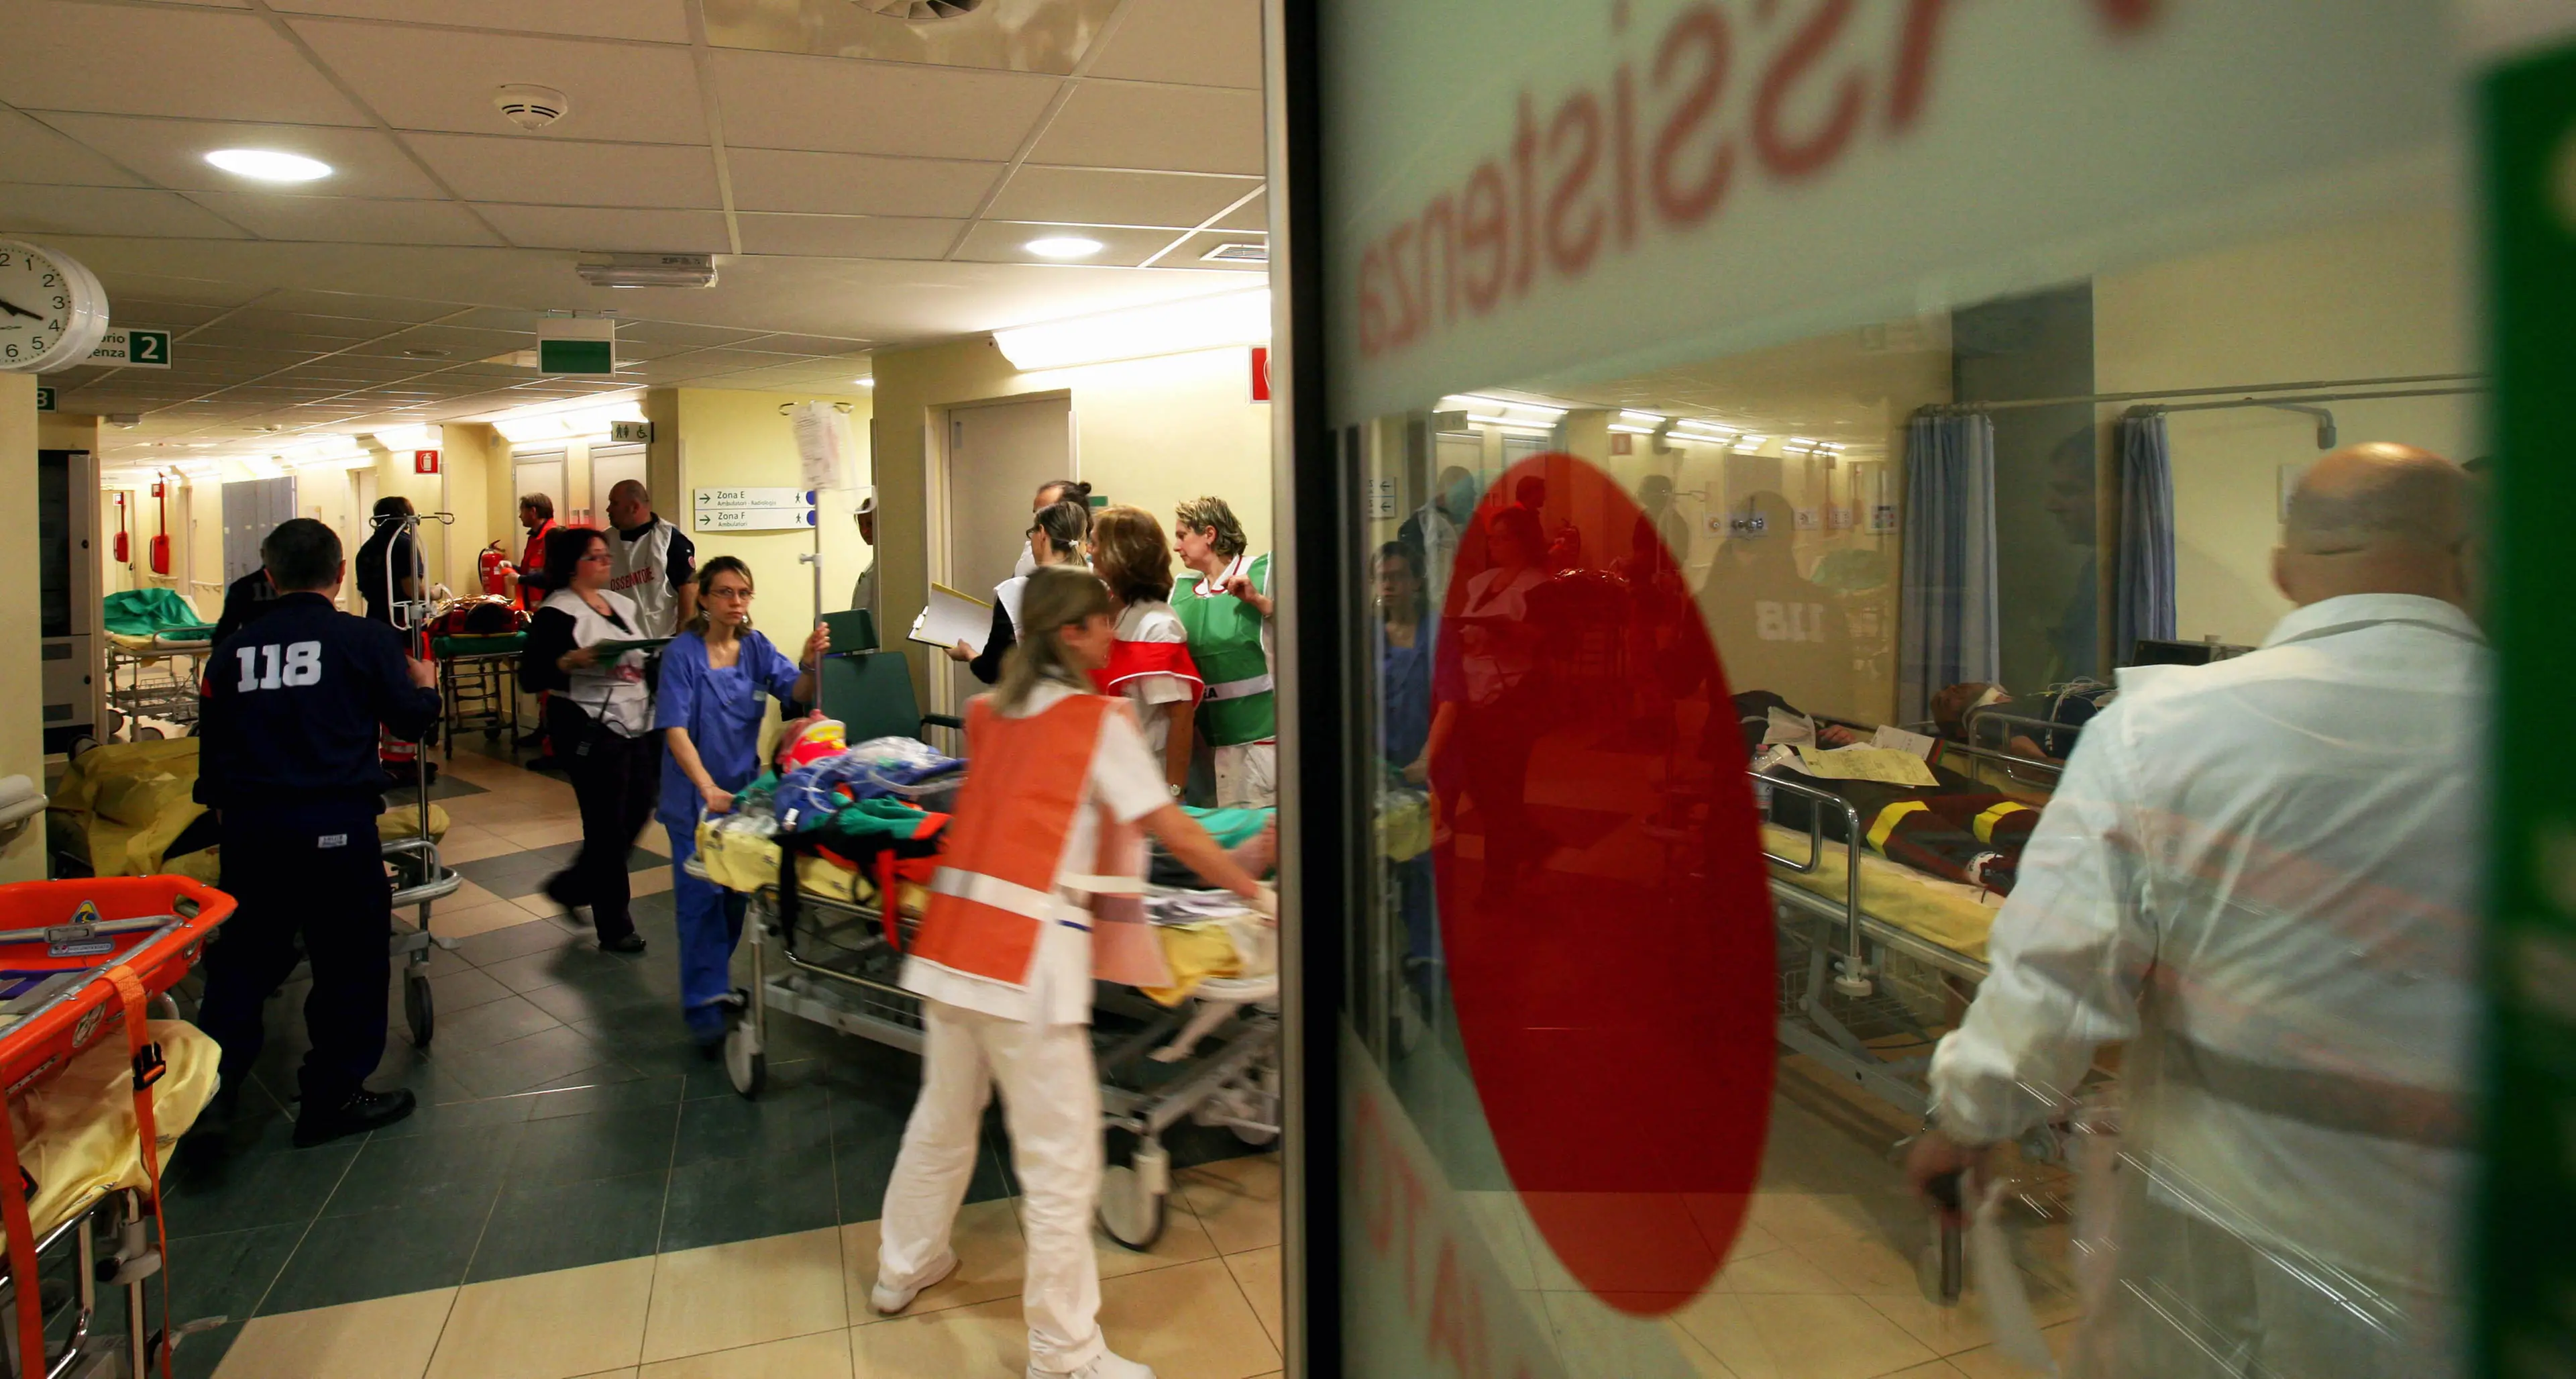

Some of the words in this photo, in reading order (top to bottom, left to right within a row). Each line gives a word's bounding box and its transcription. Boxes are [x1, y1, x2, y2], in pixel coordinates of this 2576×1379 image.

[0, 253, 11, 266] 2
[25, 258, 32, 271] 1
[42, 274, 55, 287] 2
[52, 296, 65, 309] 3
[48, 319, 60, 331] 4
[32, 336, 44, 350] 5
[140, 336, 159, 360] 2
[5, 344, 19, 358] 6
[86, 349, 125, 359] enza
[717, 491, 738, 499] Zona
[740, 491, 745, 499] E
[718, 512, 739, 520] Zona
[252, 581, 279, 601] 11
[236, 640, 322, 693] 118
